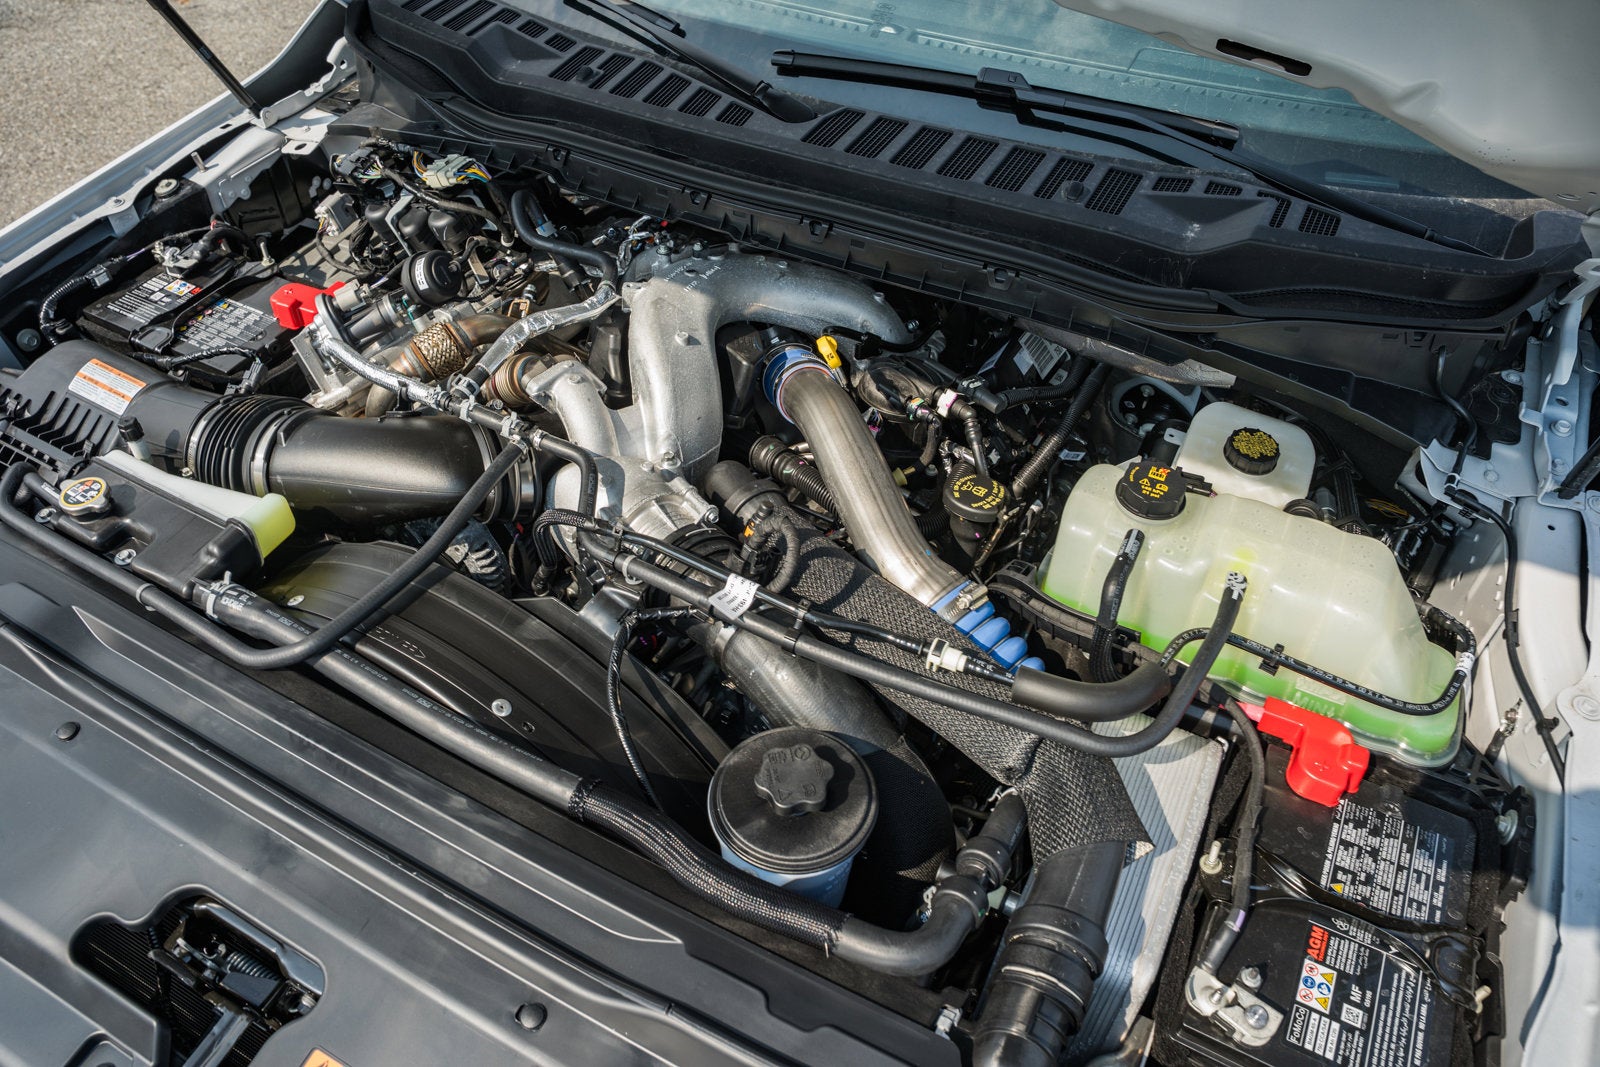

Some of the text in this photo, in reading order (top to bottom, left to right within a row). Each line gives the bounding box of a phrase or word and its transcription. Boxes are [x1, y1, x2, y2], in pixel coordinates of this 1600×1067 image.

[1305, 924, 1324, 959] AGM
[1349, 983, 1362, 1003] MF
[1290, 1007, 1305, 1043] FoMoCo
